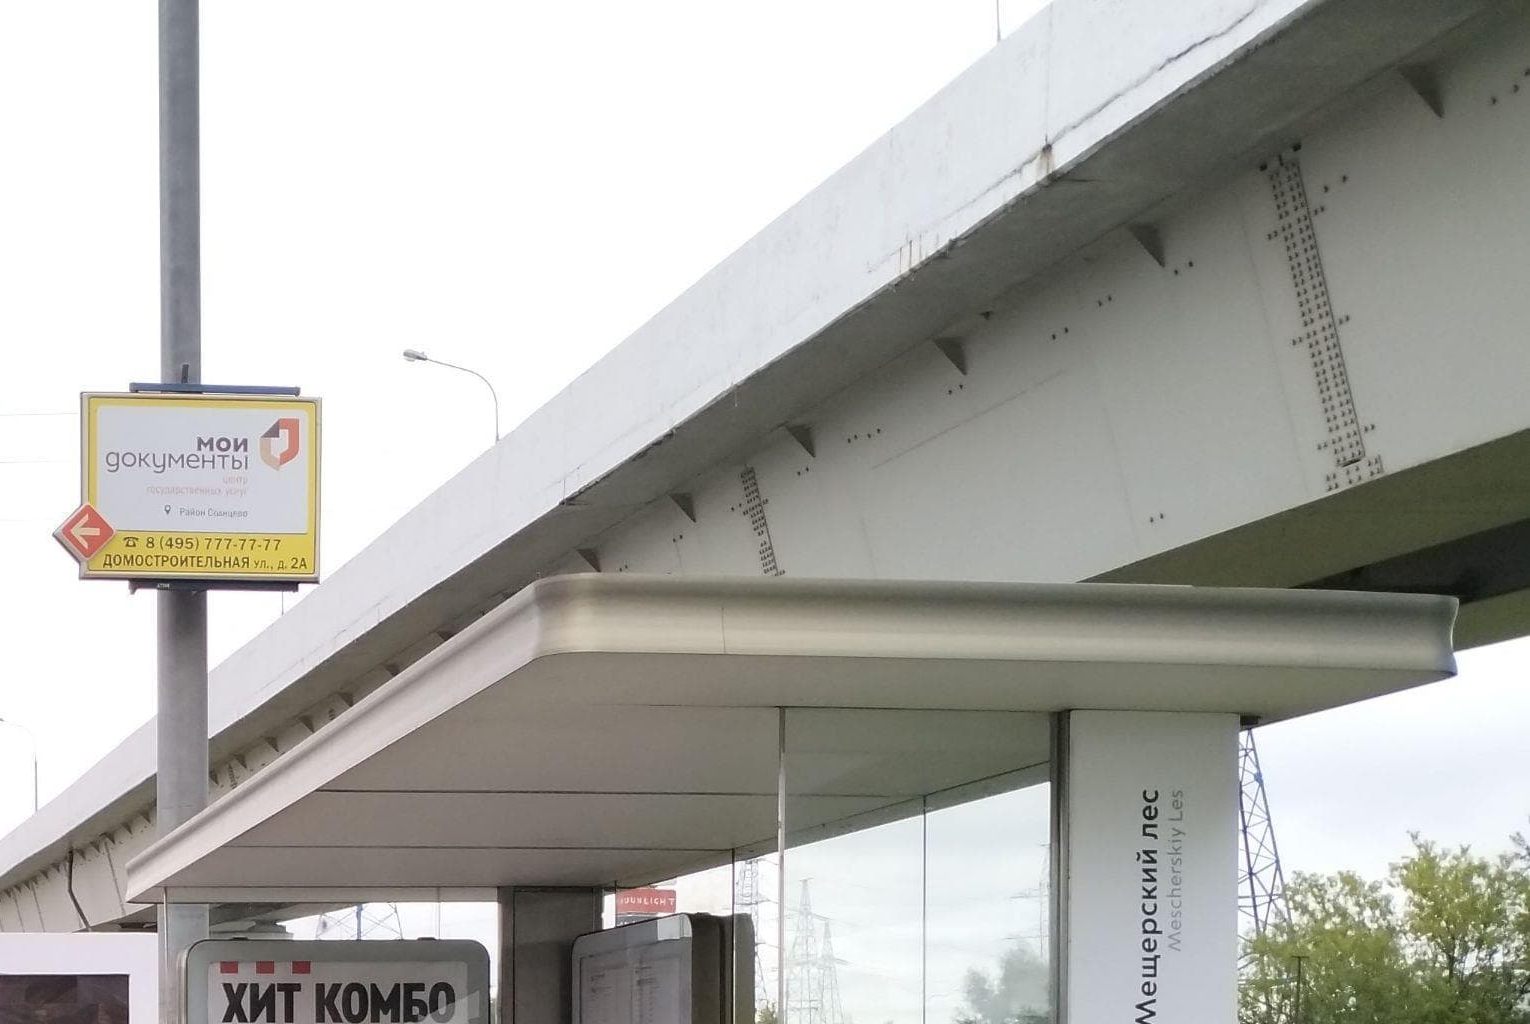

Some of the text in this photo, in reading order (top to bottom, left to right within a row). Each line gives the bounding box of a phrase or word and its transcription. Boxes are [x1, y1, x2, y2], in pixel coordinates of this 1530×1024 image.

[105, 451, 248, 473] документы
[179, 506, 248, 518] Район Солнцево
[145, 536, 281, 551] 8 (495) 777-77-77
[102, 554, 250, 569] ДОМОСТРОИТЕЛЬНАЯ
[290, 557, 308, 569] 2А
[1142, 789, 1159, 840] лес
[1167, 789, 1186, 952] Mescherskiy Les
[222, 982, 455, 1024] ХИТ КОМБО
